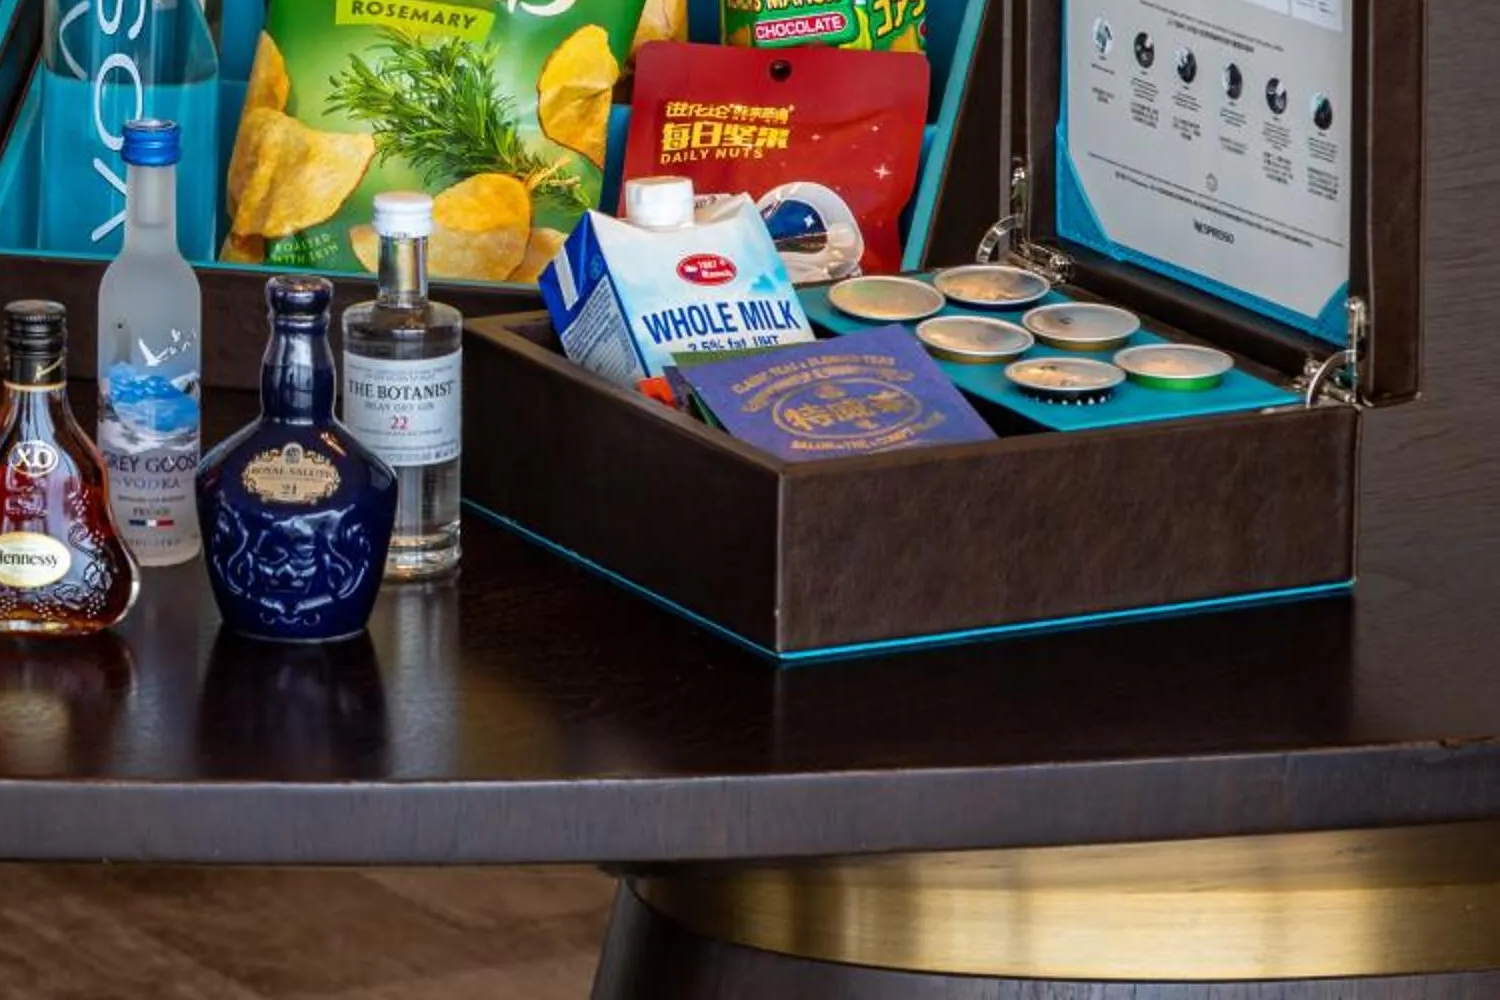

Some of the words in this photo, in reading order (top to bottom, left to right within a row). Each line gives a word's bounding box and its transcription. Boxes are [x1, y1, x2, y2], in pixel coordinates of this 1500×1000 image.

[352, 0, 476, 30] ROSEMARY
[756, 15, 842, 39] CHOCOLATE
[663, 120, 790, 151] 每日坚果
[660, 147, 710, 165] DAILY
[715, 147, 763, 160] NUTS
[642, 302, 738, 345] WHOLE
[737, 300, 802, 332] MILK
[348, 380, 374, 398] THE
[377, 382, 453, 401] BOTANIST
[391, 415, 408, 430] 22
[146, 453, 198, 473] GOOS
[123, 477, 180, 490] VODKA
